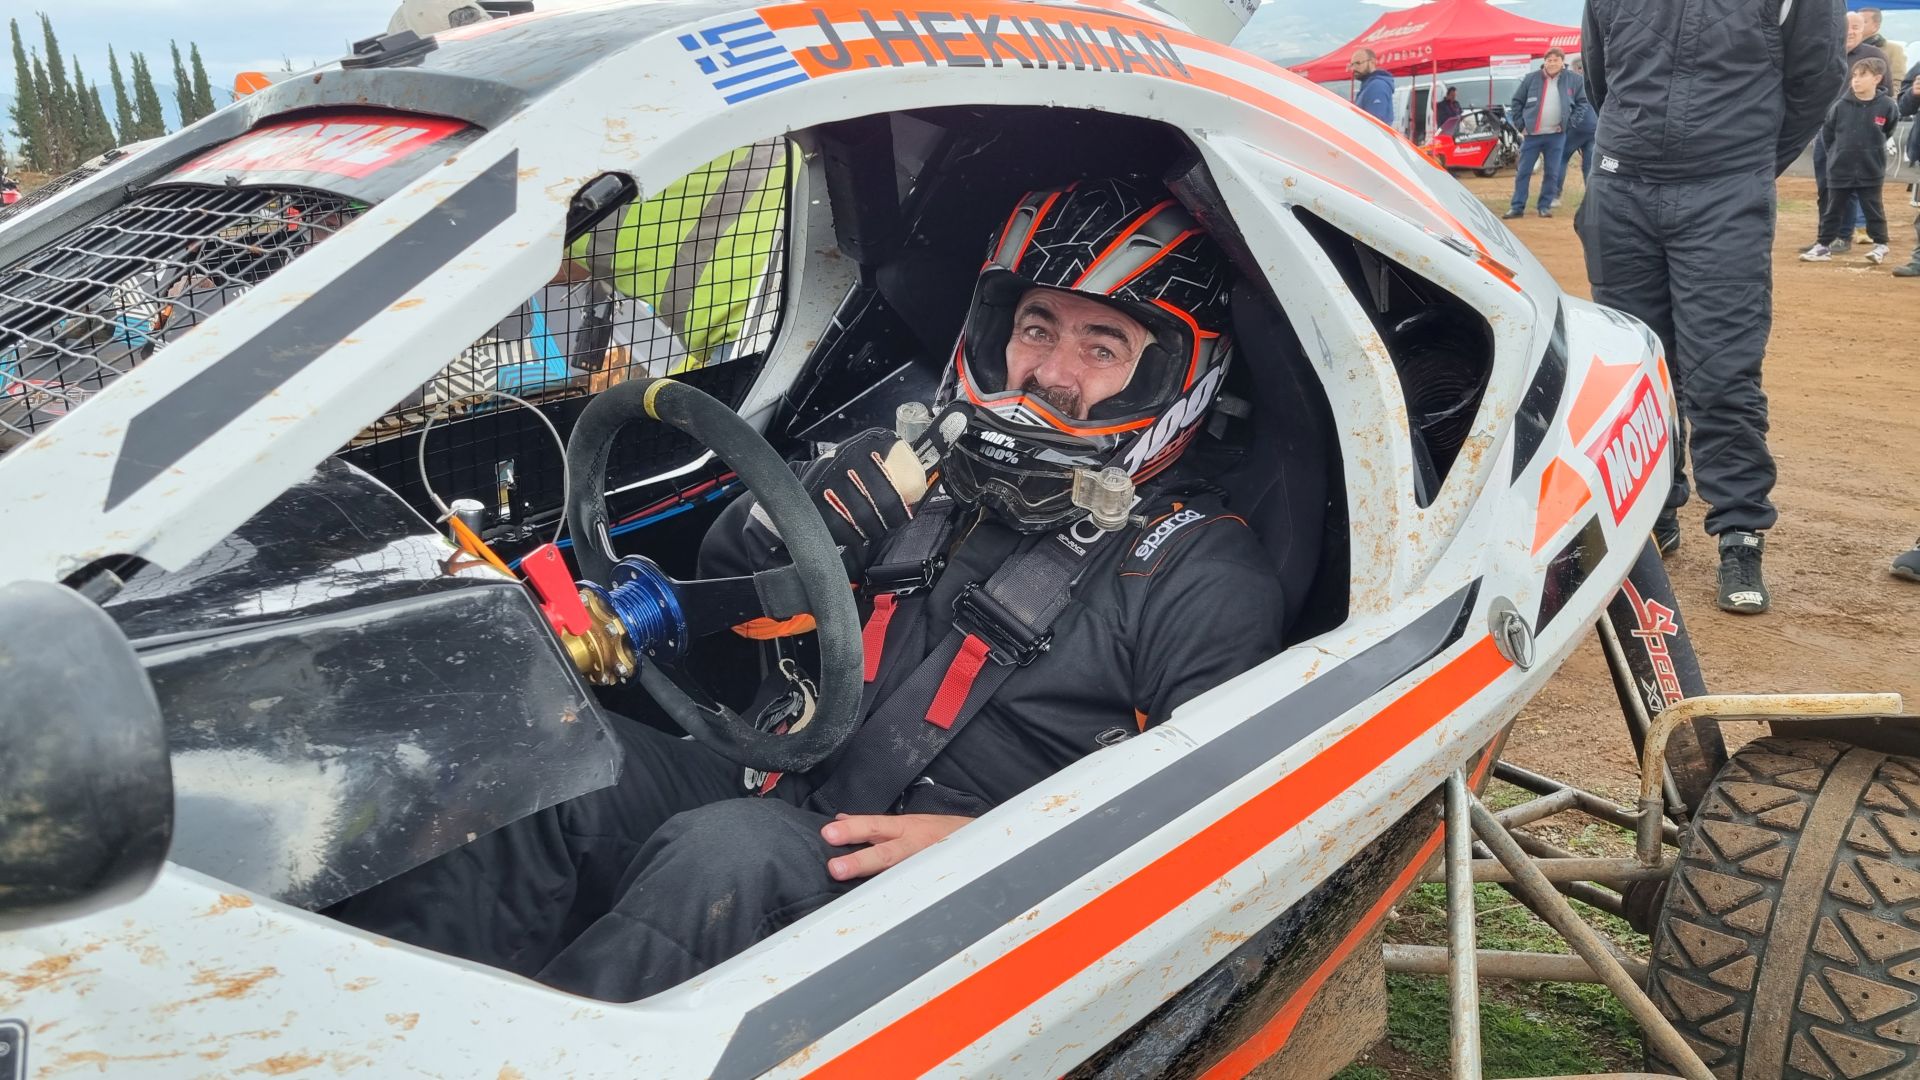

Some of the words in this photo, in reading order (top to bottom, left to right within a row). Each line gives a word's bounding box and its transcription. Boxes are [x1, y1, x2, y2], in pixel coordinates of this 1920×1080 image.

[805, 8, 1193, 80] J.HEKIMIAN
[1601, 157, 1619, 171] OMP
[980, 430, 1016, 449] 100%
[980, 445, 1019, 464] 100%
[1602, 388, 1665, 511] MOTUL
[1135, 509, 1205, 561] sparco
